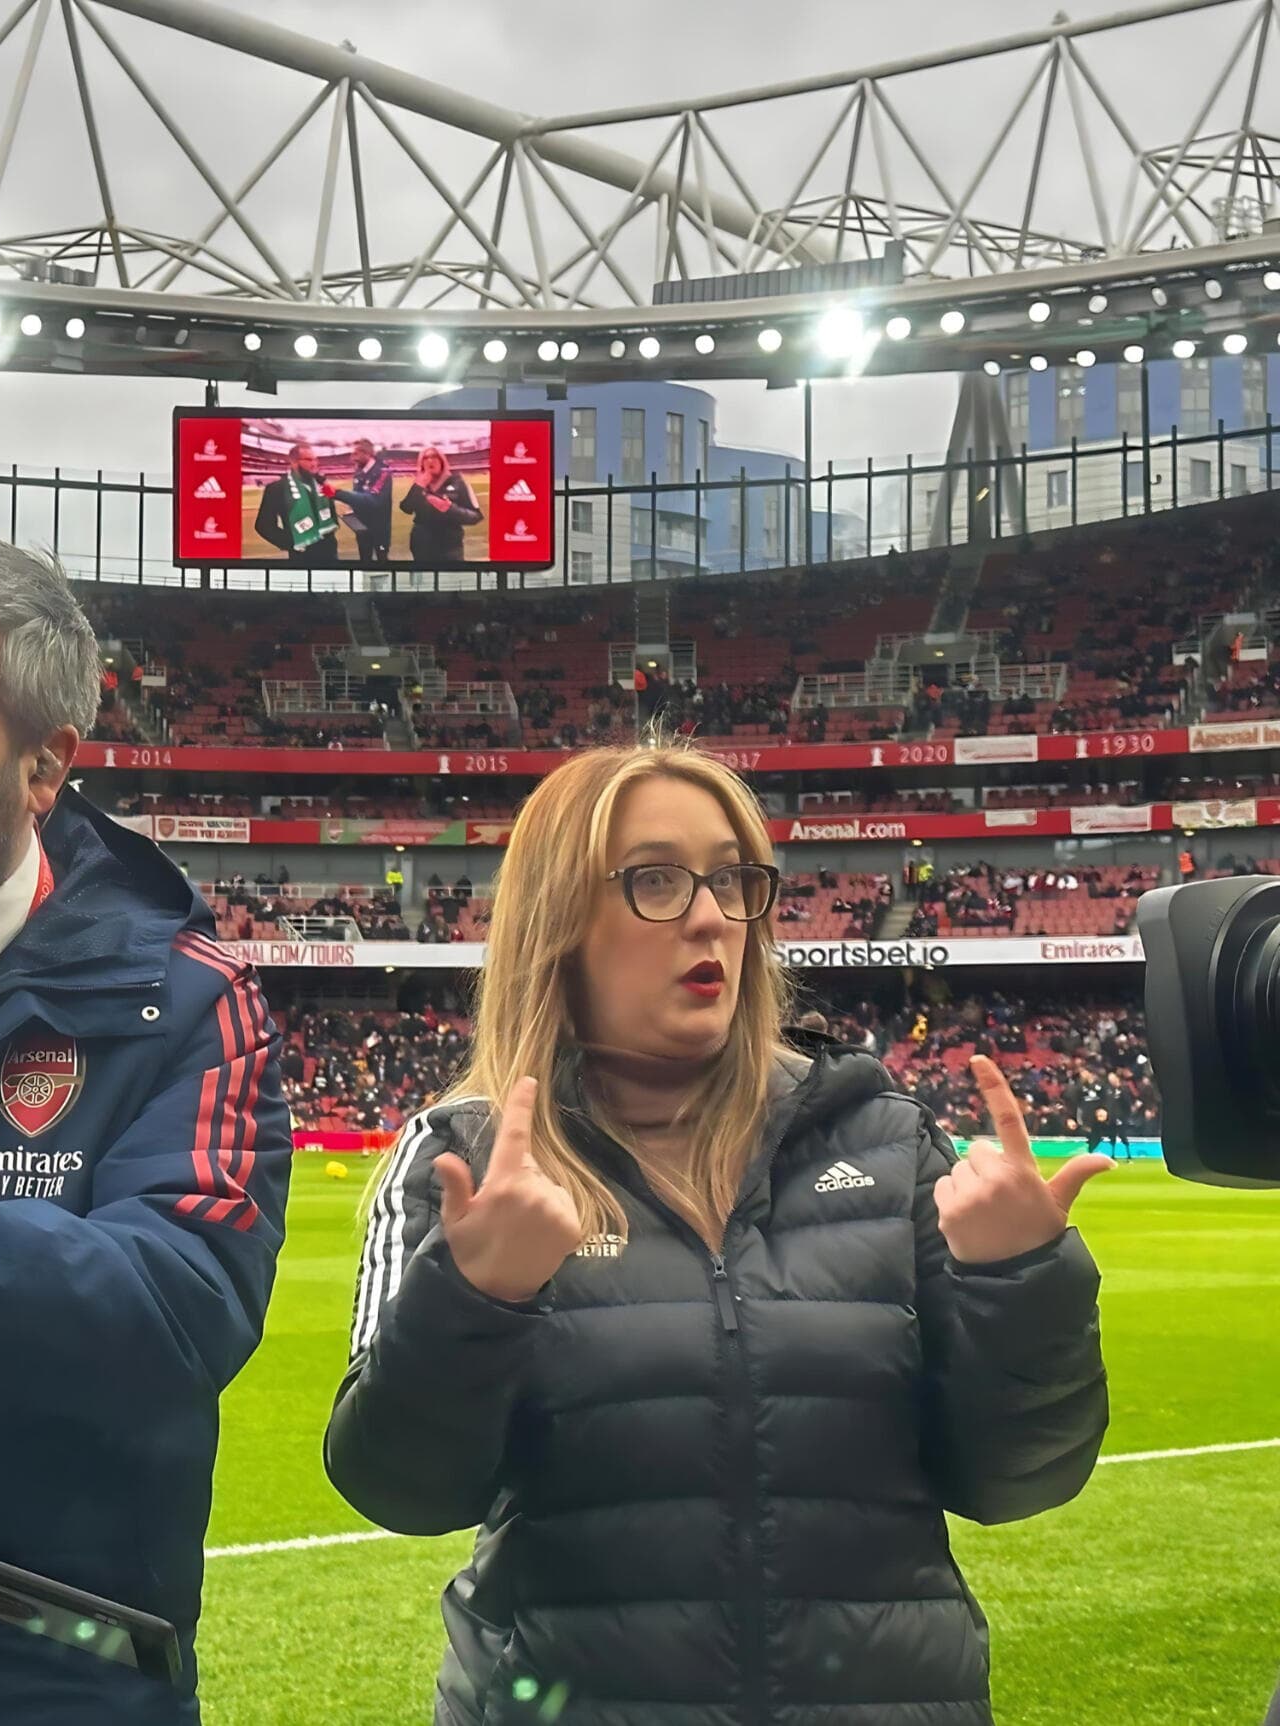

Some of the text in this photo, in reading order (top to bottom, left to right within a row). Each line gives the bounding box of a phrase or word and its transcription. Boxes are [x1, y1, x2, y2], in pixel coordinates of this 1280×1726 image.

[899, 745, 948, 763] 2020
[1100, 733, 1155, 758] 1930
[130, 749, 172, 766] 2014
[464, 754, 509, 772] 2015
[789, 819, 907, 840] Arsenal.com
[8, 1048, 73, 1064] Arsenal
[14, 1175, 65, 1199] BETTER
[814, 1175, 876, 1193] adidas
